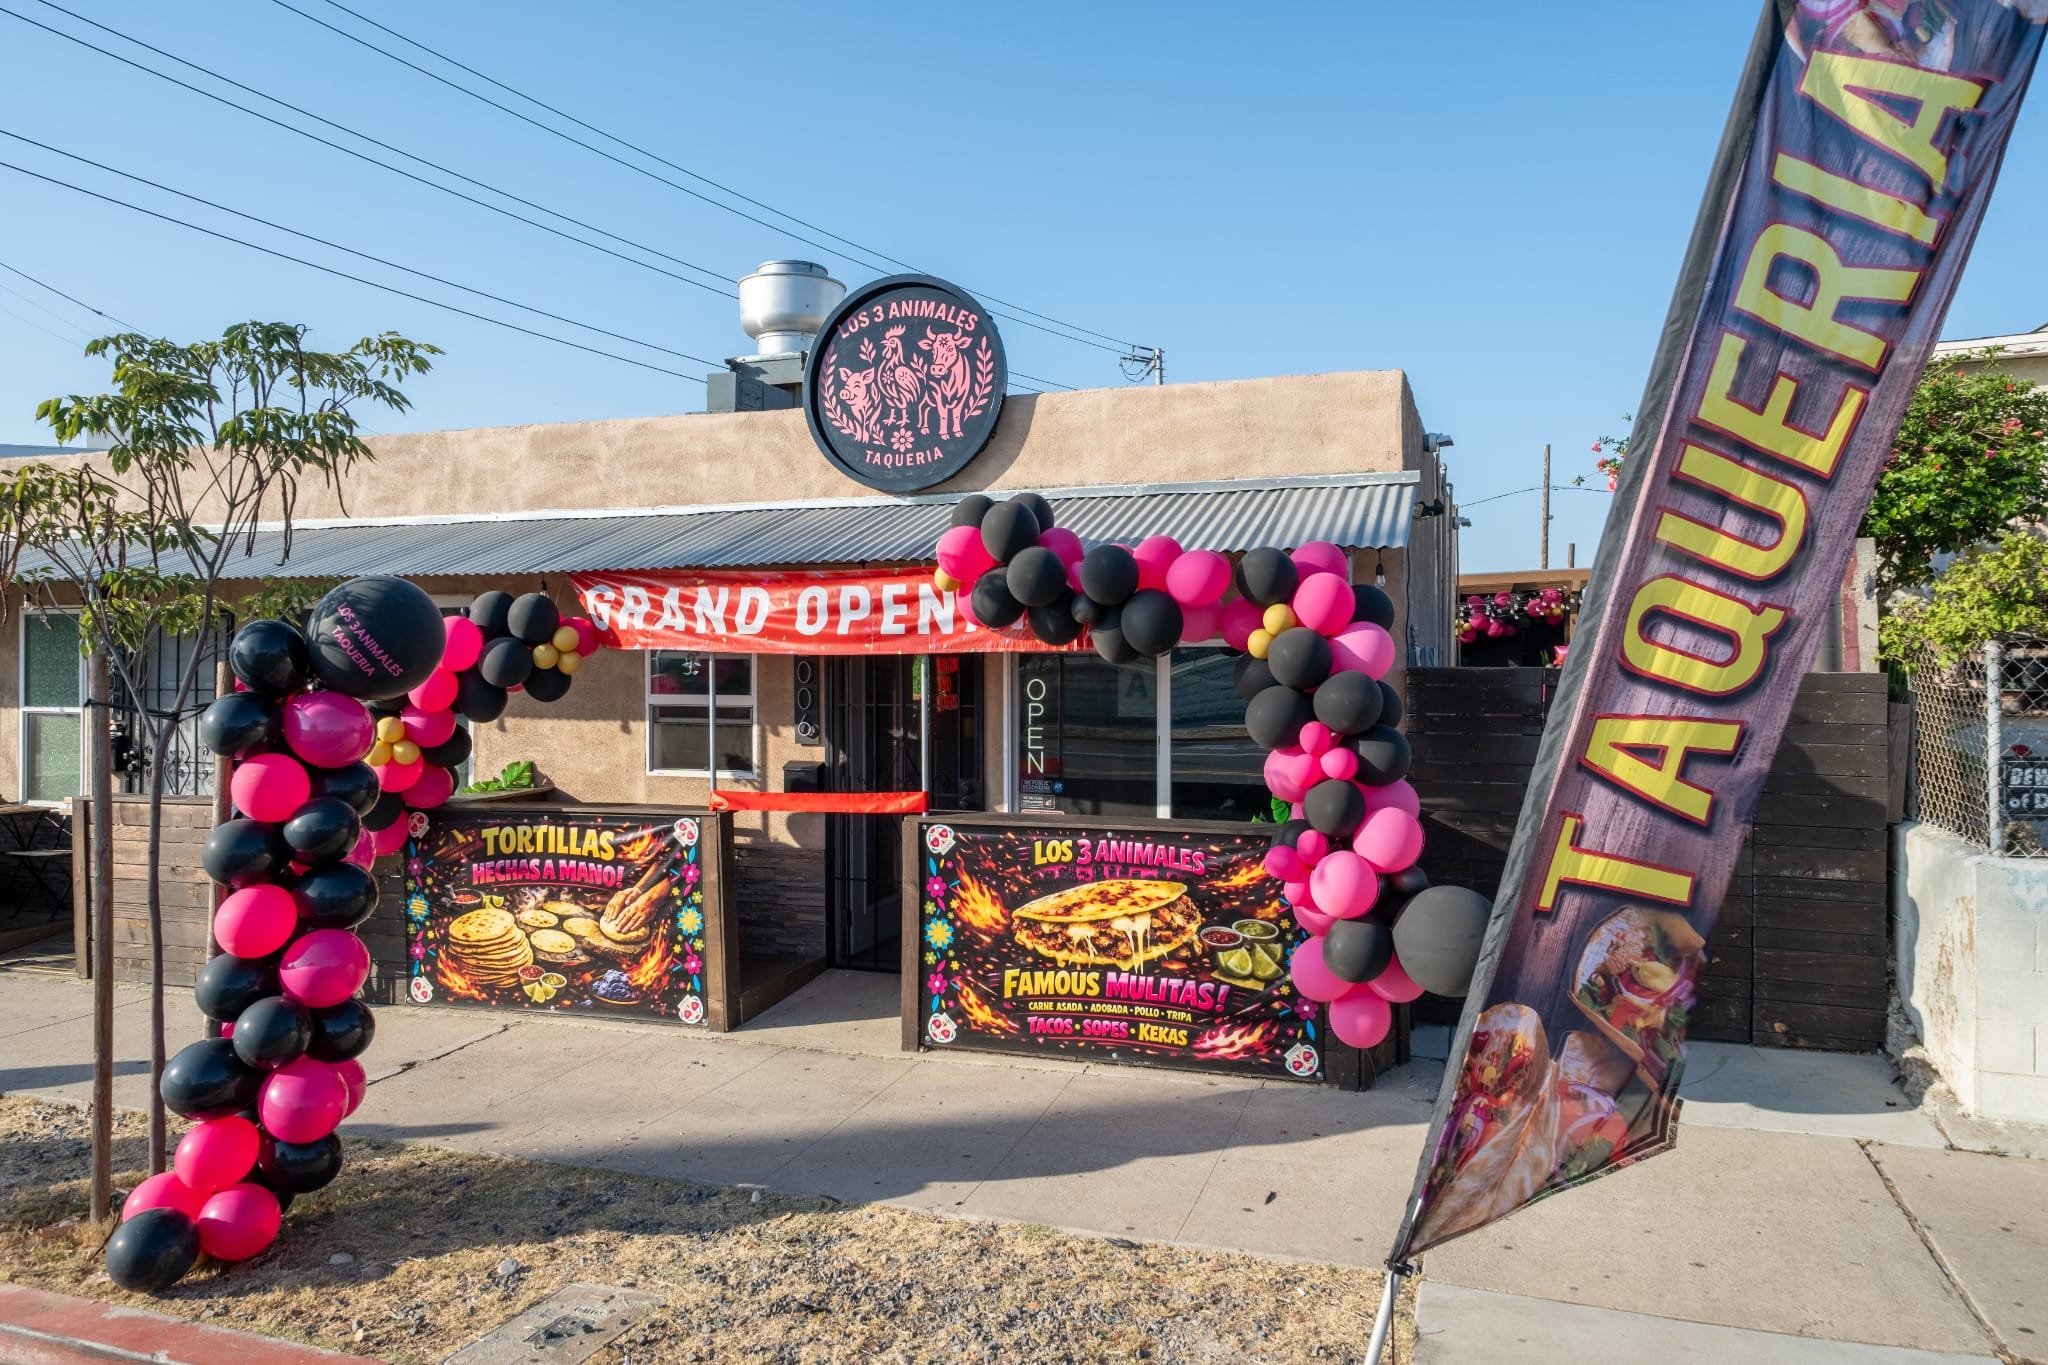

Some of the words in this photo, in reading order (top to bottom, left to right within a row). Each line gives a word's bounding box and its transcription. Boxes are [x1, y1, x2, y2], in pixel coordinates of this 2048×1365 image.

[837, 314, 870, 340] LOS
[873, 306, 885, 323] 3
[889, 300, 978, 332] ANIMALES
[865, 446, 944, 468] TAQUERIA
[1534, 46, 1989, 912] TAQUERIA
[337, 602, 355, 623] LOS
[349, 620, 361, 632] 3
[585, 584, 770, 635] GRAND
[794, 583, 1024, 635] OPEN
[331, 624, 376, 677] TAQUERIA
[354, 628, 404, 678] ANIMALES
[1126, 671, 1149, 697] A
[1026, 678, 1046, 775] OPEN
[481, 824, 617, 861] TORTILLAS
[1034, 840, 1073, 865] LOS
[1076, 839, 1092, 864] 3
[1095, 840, 1206, 876] ANIMALES
[471, 858, 541, 886] HECHAS
[542, 860, 555, 882] A
[559, 859, 625, 889] MANO!
[1003, 968, 1101, 998] FAMOUS
[1106, 971, 1231, 1012] MULITAS!
[1028, 1001, 1054, 1011] CARNE
[1056, 1002, 1083, 1012] ASADA
[1090, 1004, 1129, 1014] ADOBADA
[1134, 1006, 1160, 1017] POLLO
[1167, 1009, 1192, 1022] TRIPA
[1027, 1016, 1073, 1035] TACOS
[1082, 1019, 1129, 1038] SOPES
[1138, 1022, 1188, 1046] KEKAS
